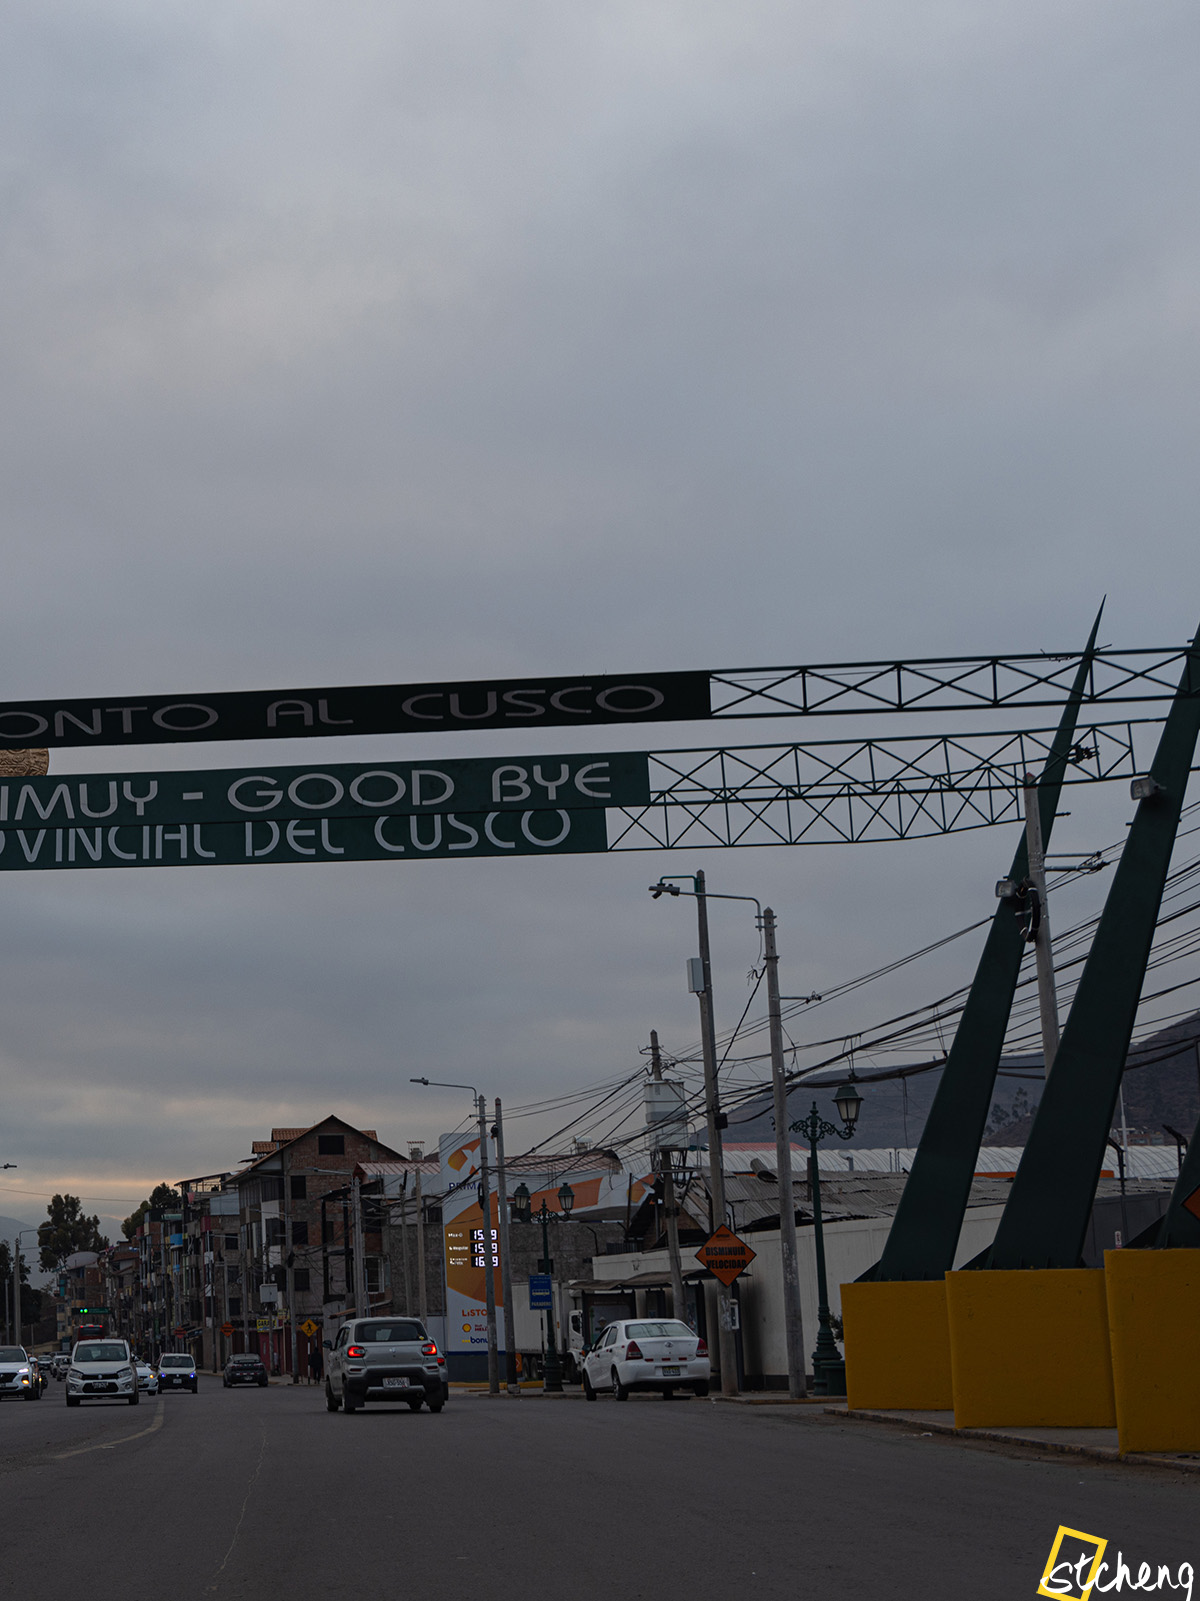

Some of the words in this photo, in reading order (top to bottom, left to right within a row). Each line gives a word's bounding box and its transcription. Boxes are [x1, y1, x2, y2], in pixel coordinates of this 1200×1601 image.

[267, 698, 354, 727] AL
[401, 685, 665, 720] CUSCO
[227, 769, 455, 813] GOOD
[491, 762, 611, 803] BYE
[245, 818, 345, 857] DEL
[374, 809, 571, 852] CUSCO
[705, 1246, 746, 1256] DISMINUIR
[706, 1259, 746, 1269] VELOCIDAD
